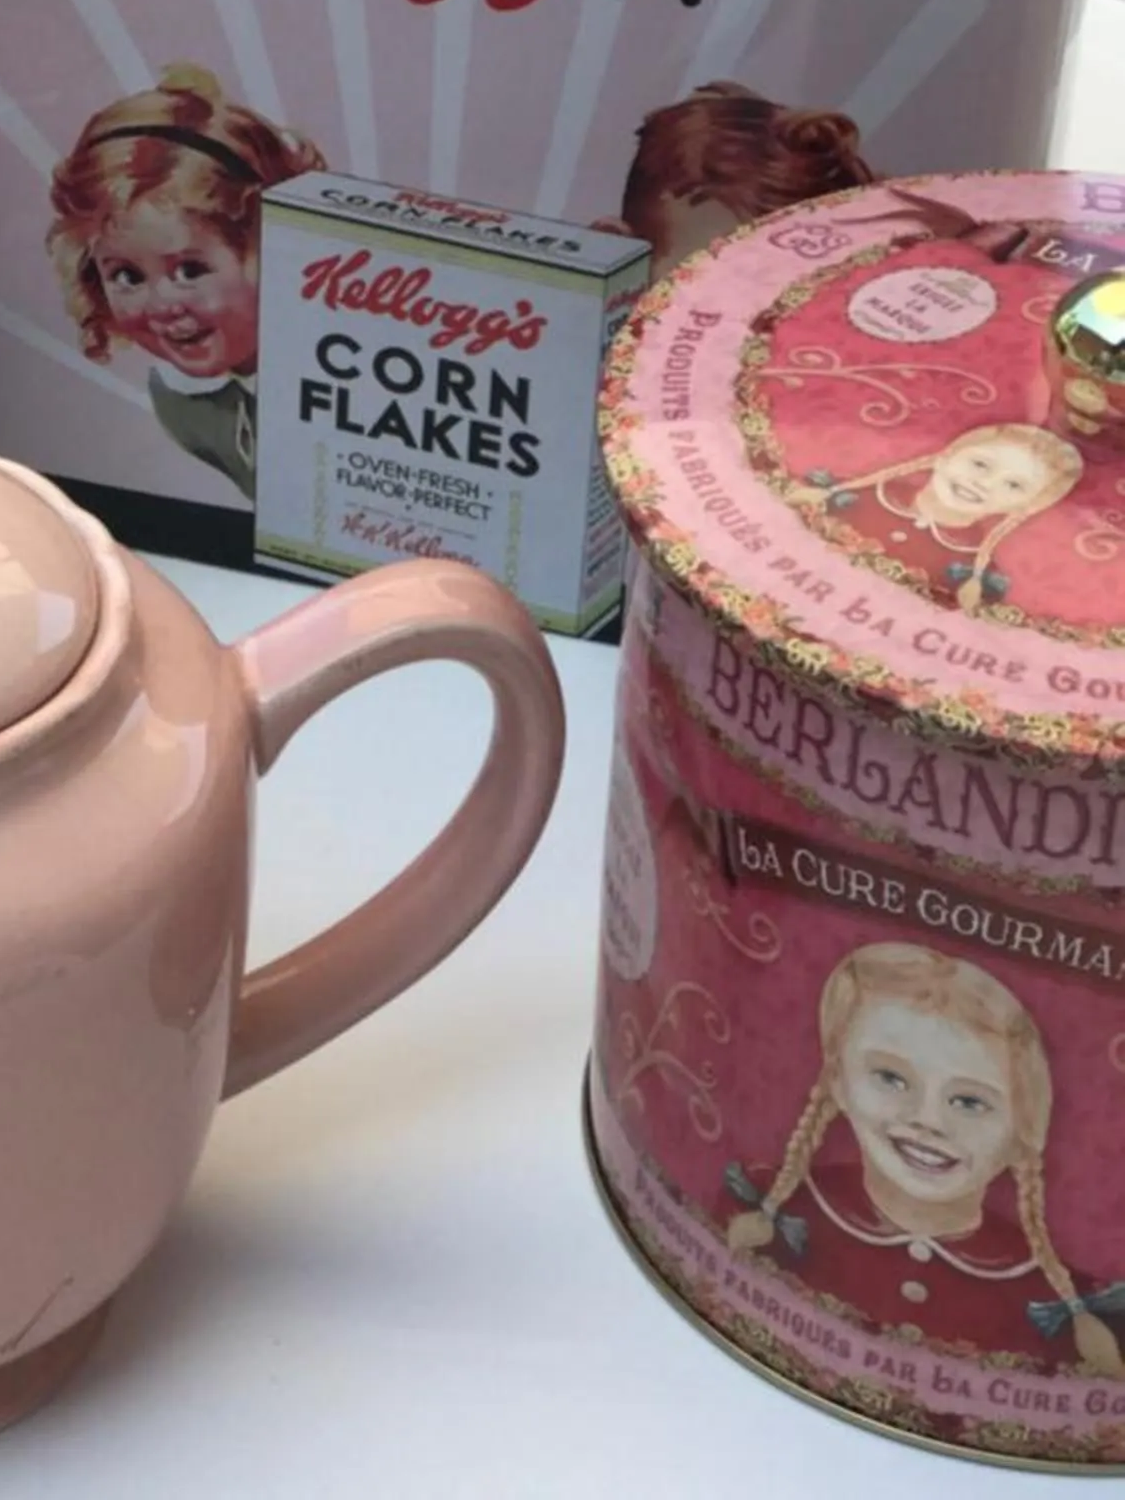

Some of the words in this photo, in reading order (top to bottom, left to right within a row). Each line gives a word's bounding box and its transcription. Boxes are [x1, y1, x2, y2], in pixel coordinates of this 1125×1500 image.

[299, 249, 549, 356] Kellogg's
[298, 377, 542, 479] FLAKES
[314, 332, 532, 426] CORN
[347, 450, 480, 500] OVEN-FRESH
[660, 307, 723, 422] PRODUITS
[767, 555, 837, 605] PAR
[911, 628, 1028, 684] CURE
[791, 848, 907, 916] CURE
[916, 888, 1125, 982] GOURMA
[862, 1349, 918, 1385] PAR
[986, 1377, 1073, 1415] CURE
